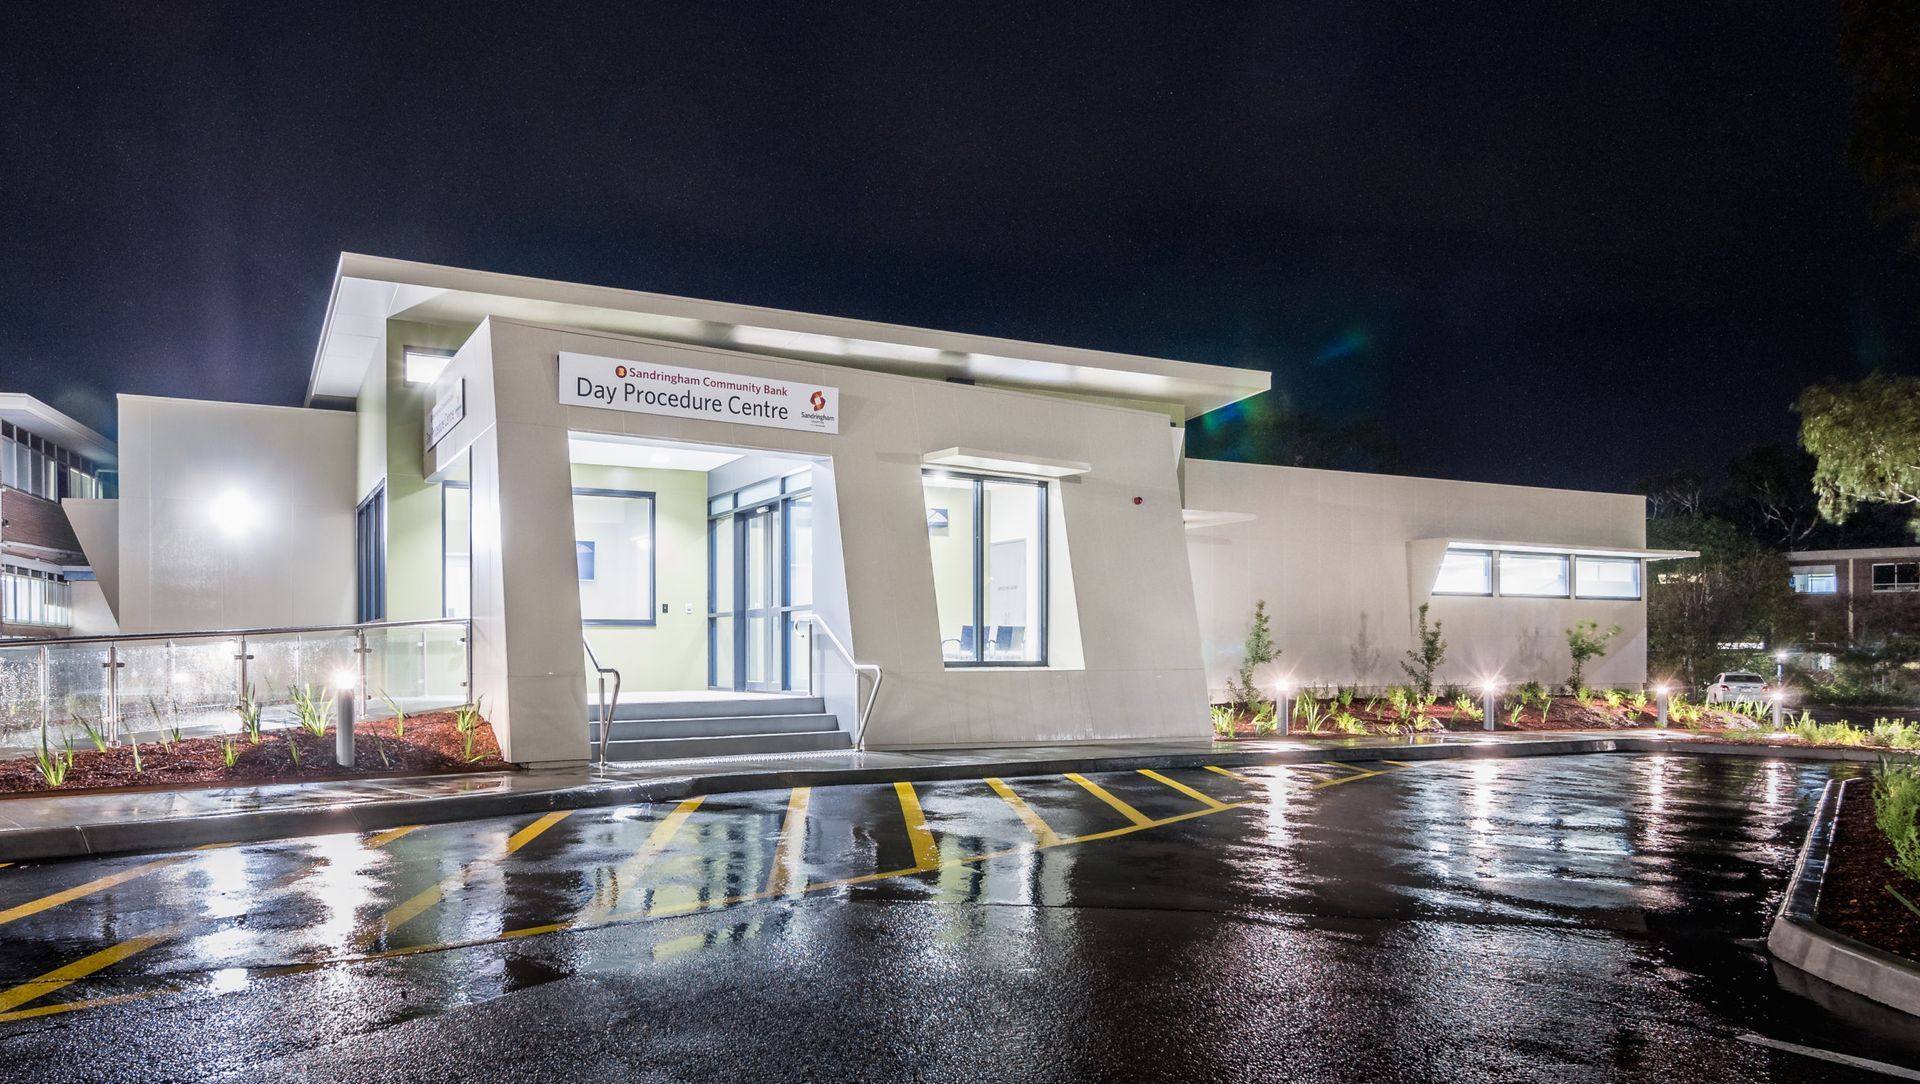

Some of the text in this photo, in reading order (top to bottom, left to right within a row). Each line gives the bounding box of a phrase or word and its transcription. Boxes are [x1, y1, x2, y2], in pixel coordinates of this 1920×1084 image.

[629, 368, 788, 396] Sandringham Community Bank
[577, 377, 788, 420] Day Procedure Centre
[801, 412, 835, 421] Sandringham
